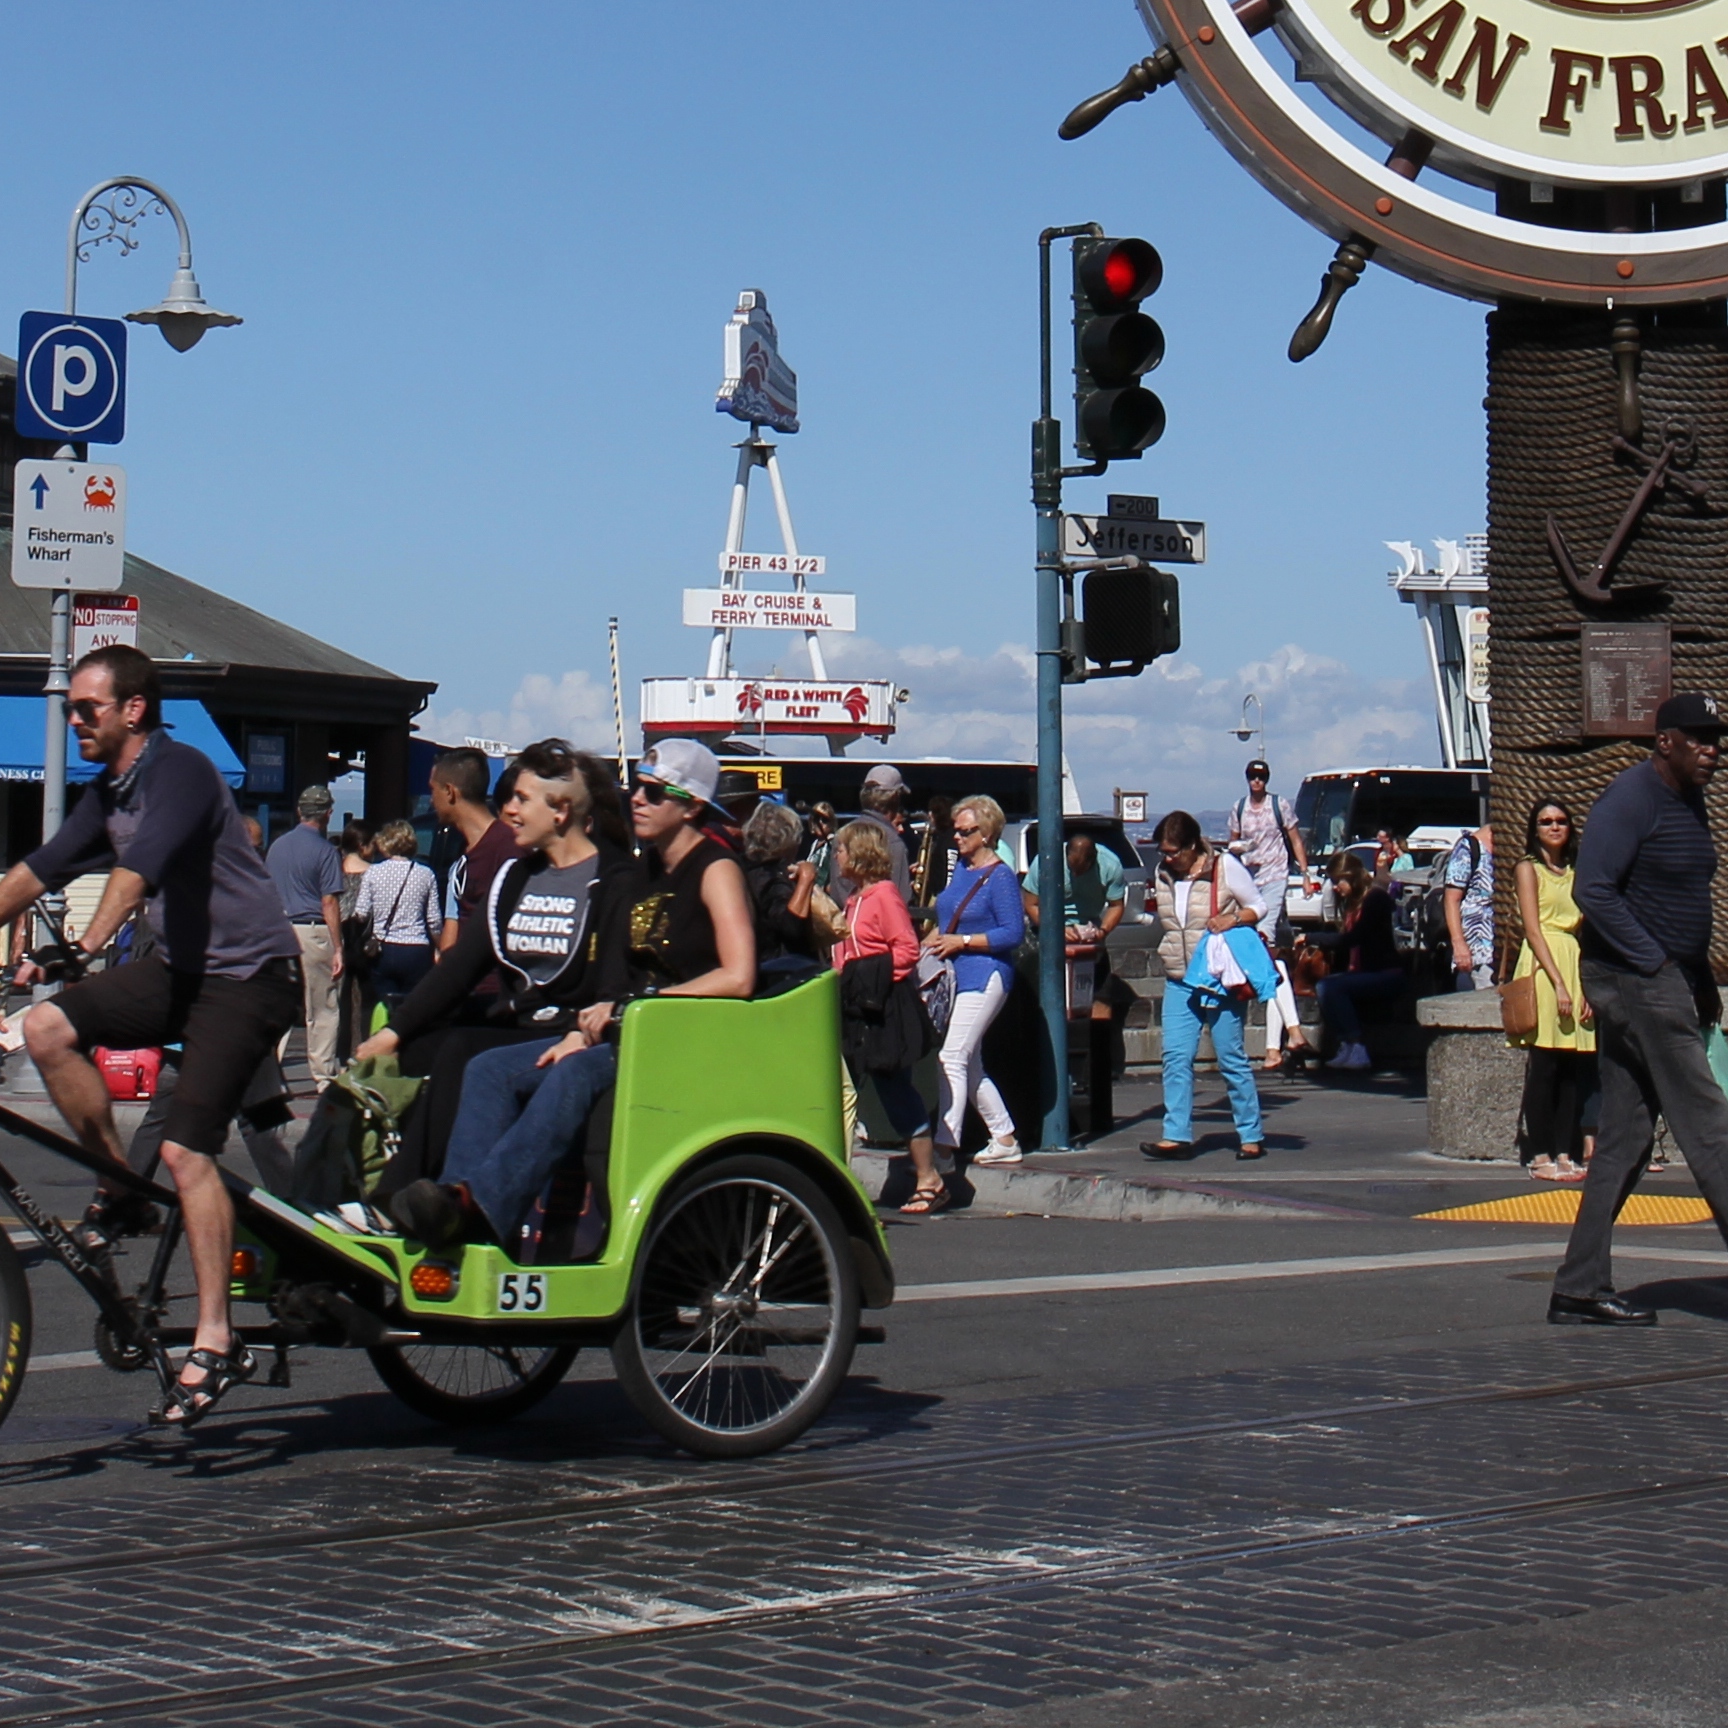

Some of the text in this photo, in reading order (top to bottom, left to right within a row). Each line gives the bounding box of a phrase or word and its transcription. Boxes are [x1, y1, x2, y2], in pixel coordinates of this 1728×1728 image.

[28, 527, 114, 545] Fisherman's
[1076, 524, 1193, 554] Jefferson
[28, 546, 71, 562] Wharf
[729, 556, 818, 572] PIER 43 1/2
[722, 594, 822, 609] BAY CRUISE &
[75, 609, 137, 627] NO STOPPING
[712, 610, 832, 627] FERRY TERMINAL
[91, 634, 119, 646] ANY
[765, 689, 843, 702] RED & WHITE
[786, 705, 820, 718] FLEET
[519, 894, 576, 914] STRONG
[507, 912, 575, 934] ATHLETIC
[506, 933, 568, 954] WOMAN
[10, 1184, 89, 1274] MAIN STREET
[500, 1274, 542, 1311] 55
